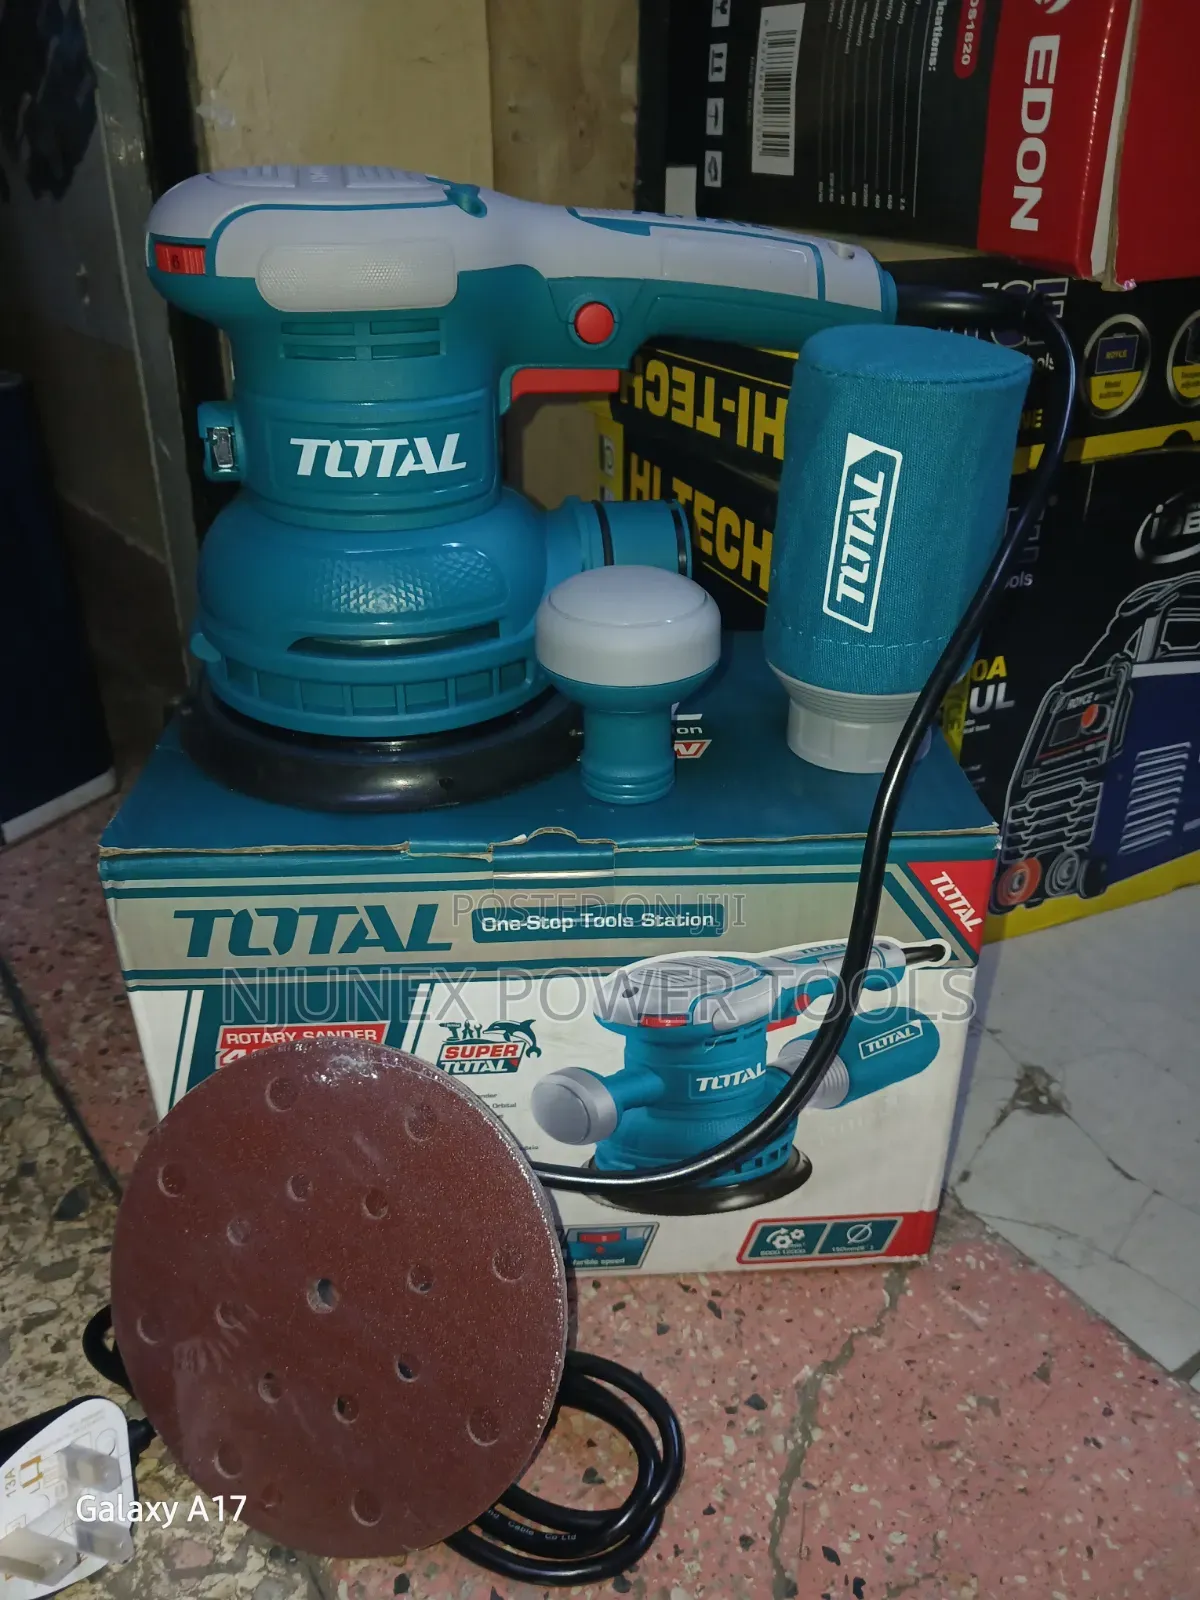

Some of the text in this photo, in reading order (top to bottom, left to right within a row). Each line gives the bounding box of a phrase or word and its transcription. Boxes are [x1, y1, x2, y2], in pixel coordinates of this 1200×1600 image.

[928, 0, 948, 72] ications:
[1010, 35, 1061, 231] EDON
[290, 433, 467, 478] TOTAL
[630, 452, 773, 593] HITECH
[836, 471, 885, 604] TOTAL
[930, 871, 983, 932] TOTAL
[173, 903, 454, 958] TOTAL
[481, 911, 715, 932] One-Stop Tools Station
[226, 1029, 377, 1045] ROTARY SANDER
[445, 1044, 519, 1059] SUPER
[864, 1027, 916, 1055] TOTAL
[441, 1060, 508, 1074] TOTAL
[696, 1062, 767, 1092] TOTAL
[4, 1467, 16, 1498] 13A
[508, 1521, 534, 1536] Cable
[561, 1533, 577, 1541] Ltd
